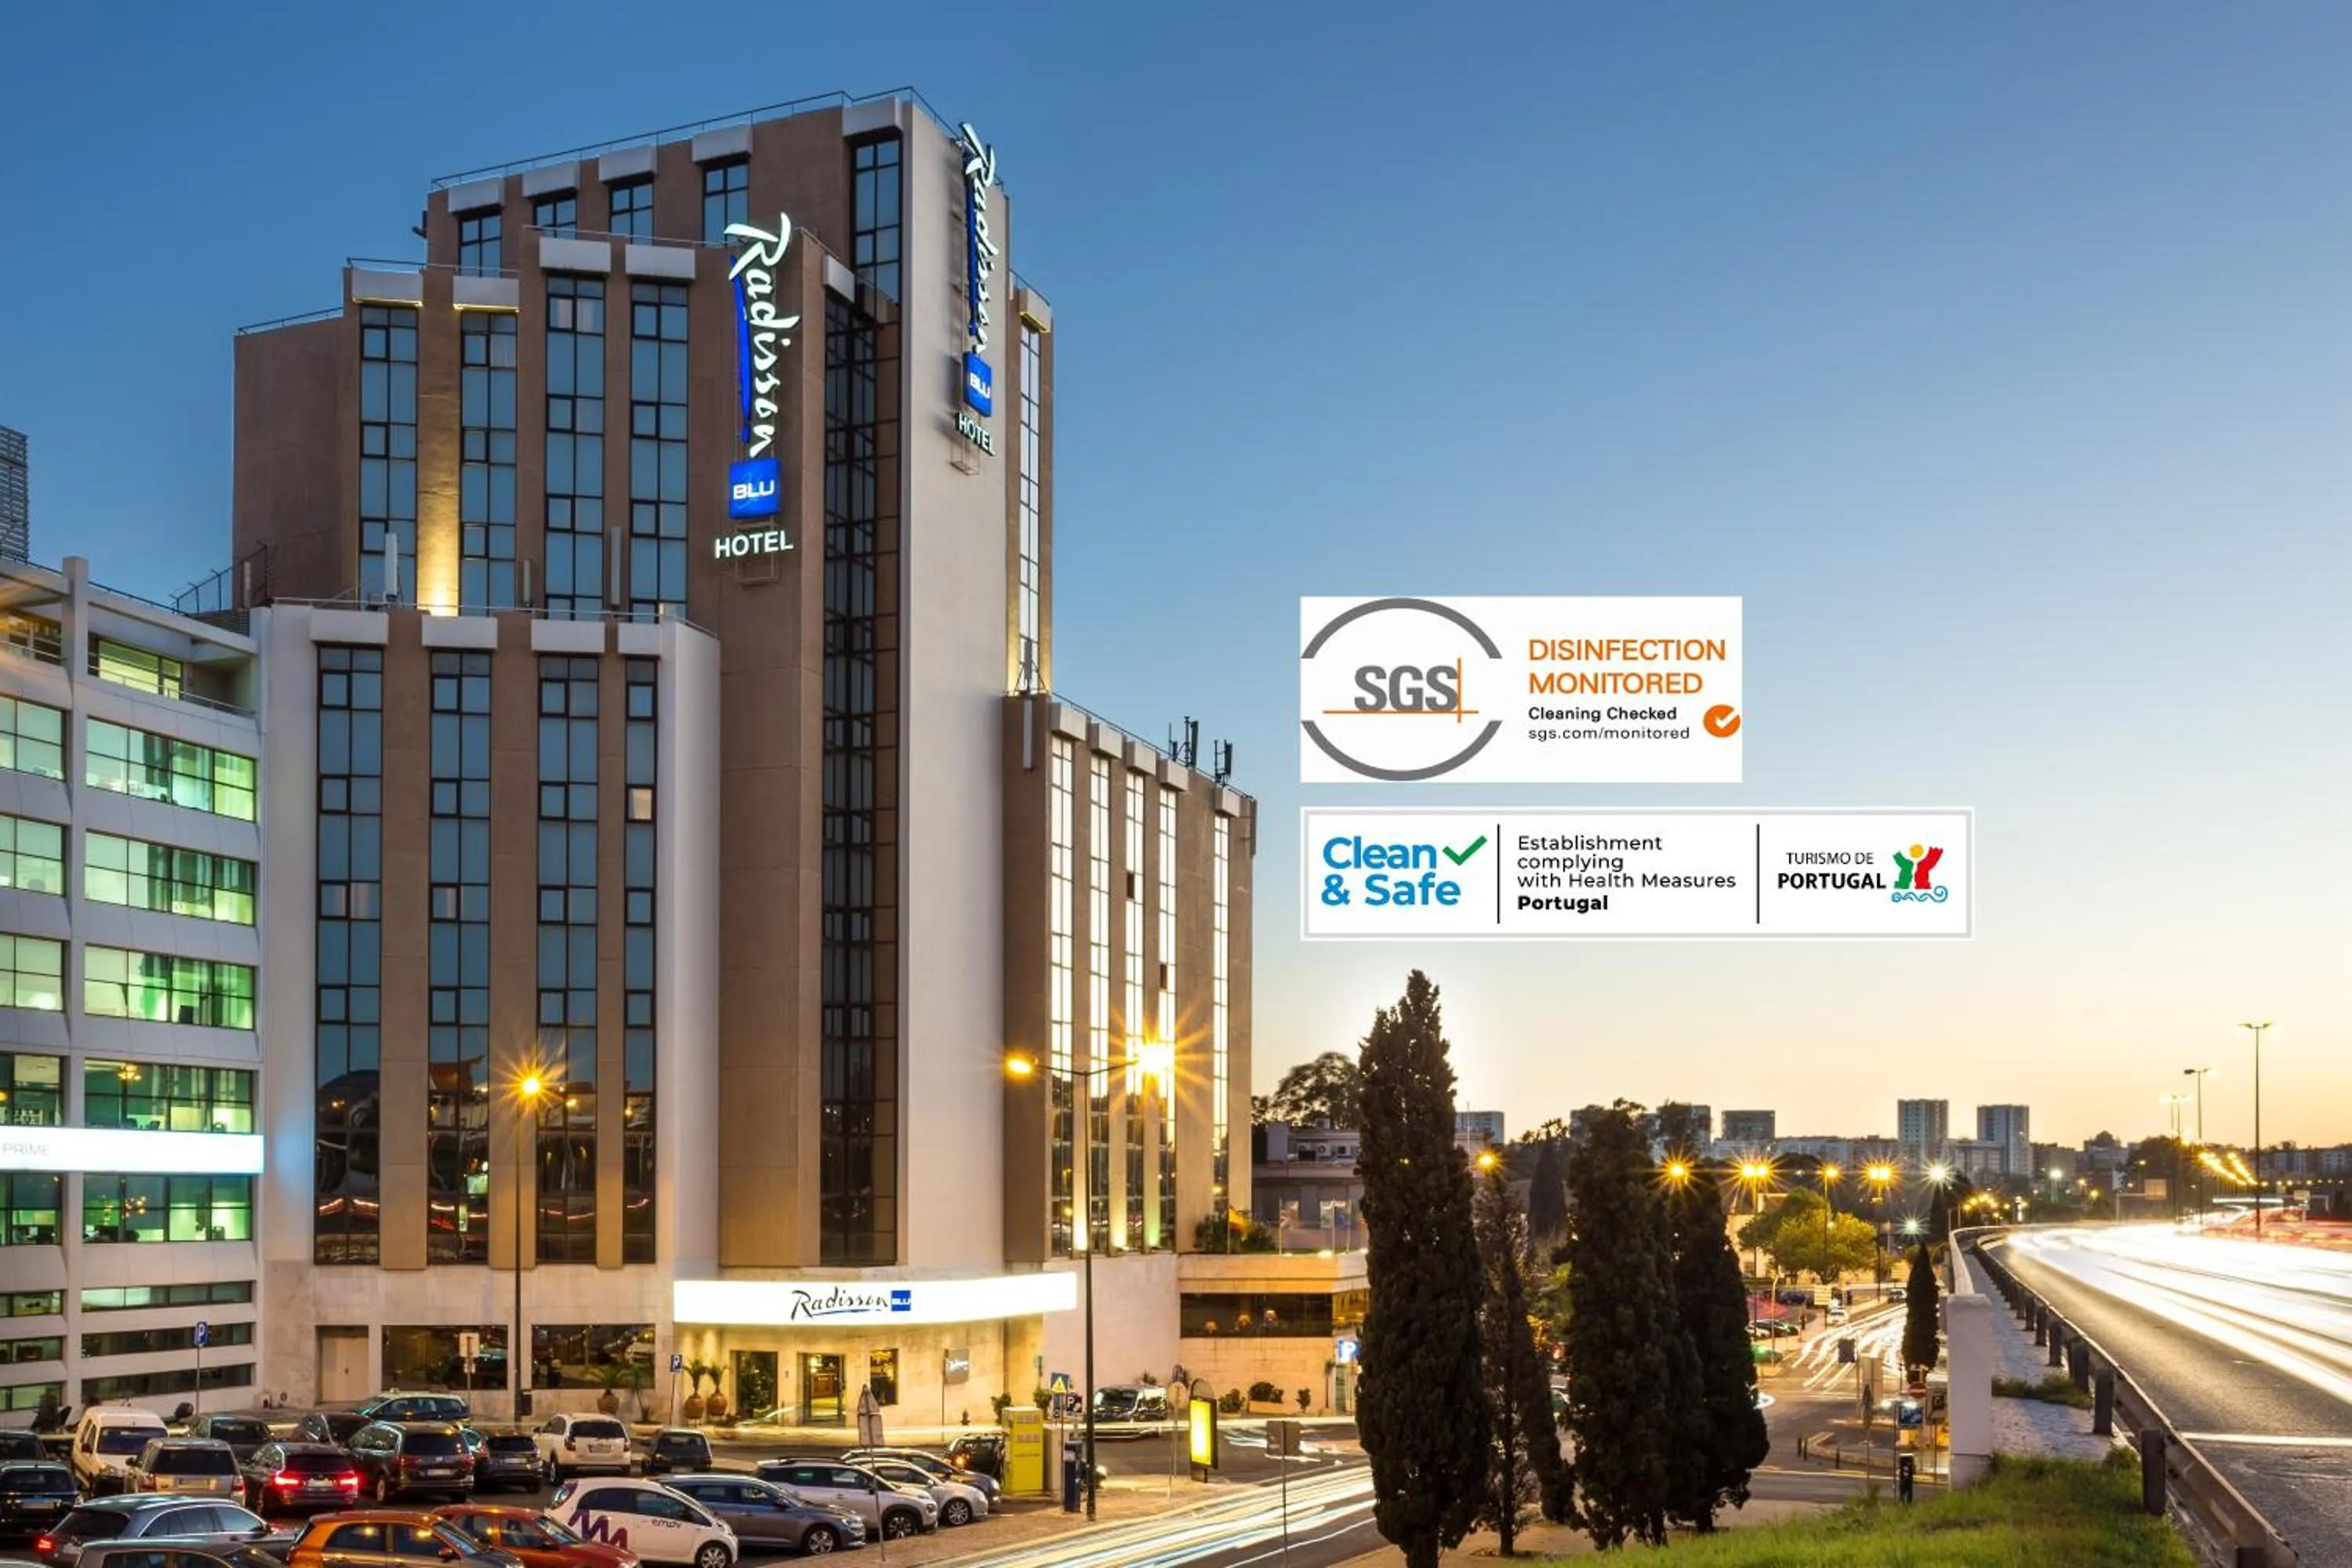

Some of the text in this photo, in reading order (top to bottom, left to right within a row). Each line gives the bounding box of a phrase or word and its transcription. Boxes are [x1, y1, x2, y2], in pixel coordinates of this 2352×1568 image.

[960, 122, 999, 355] Radisson
[724, 212, 800, 459] Radisson
[969, 373, 990, 398] BLU
[957, 412, 996, 456] HOTEL
[733, 482, 775, 499] BLU
[714, 531, 793, 559] HOTEL
[790, 1287, 888, 1320] Radisson
